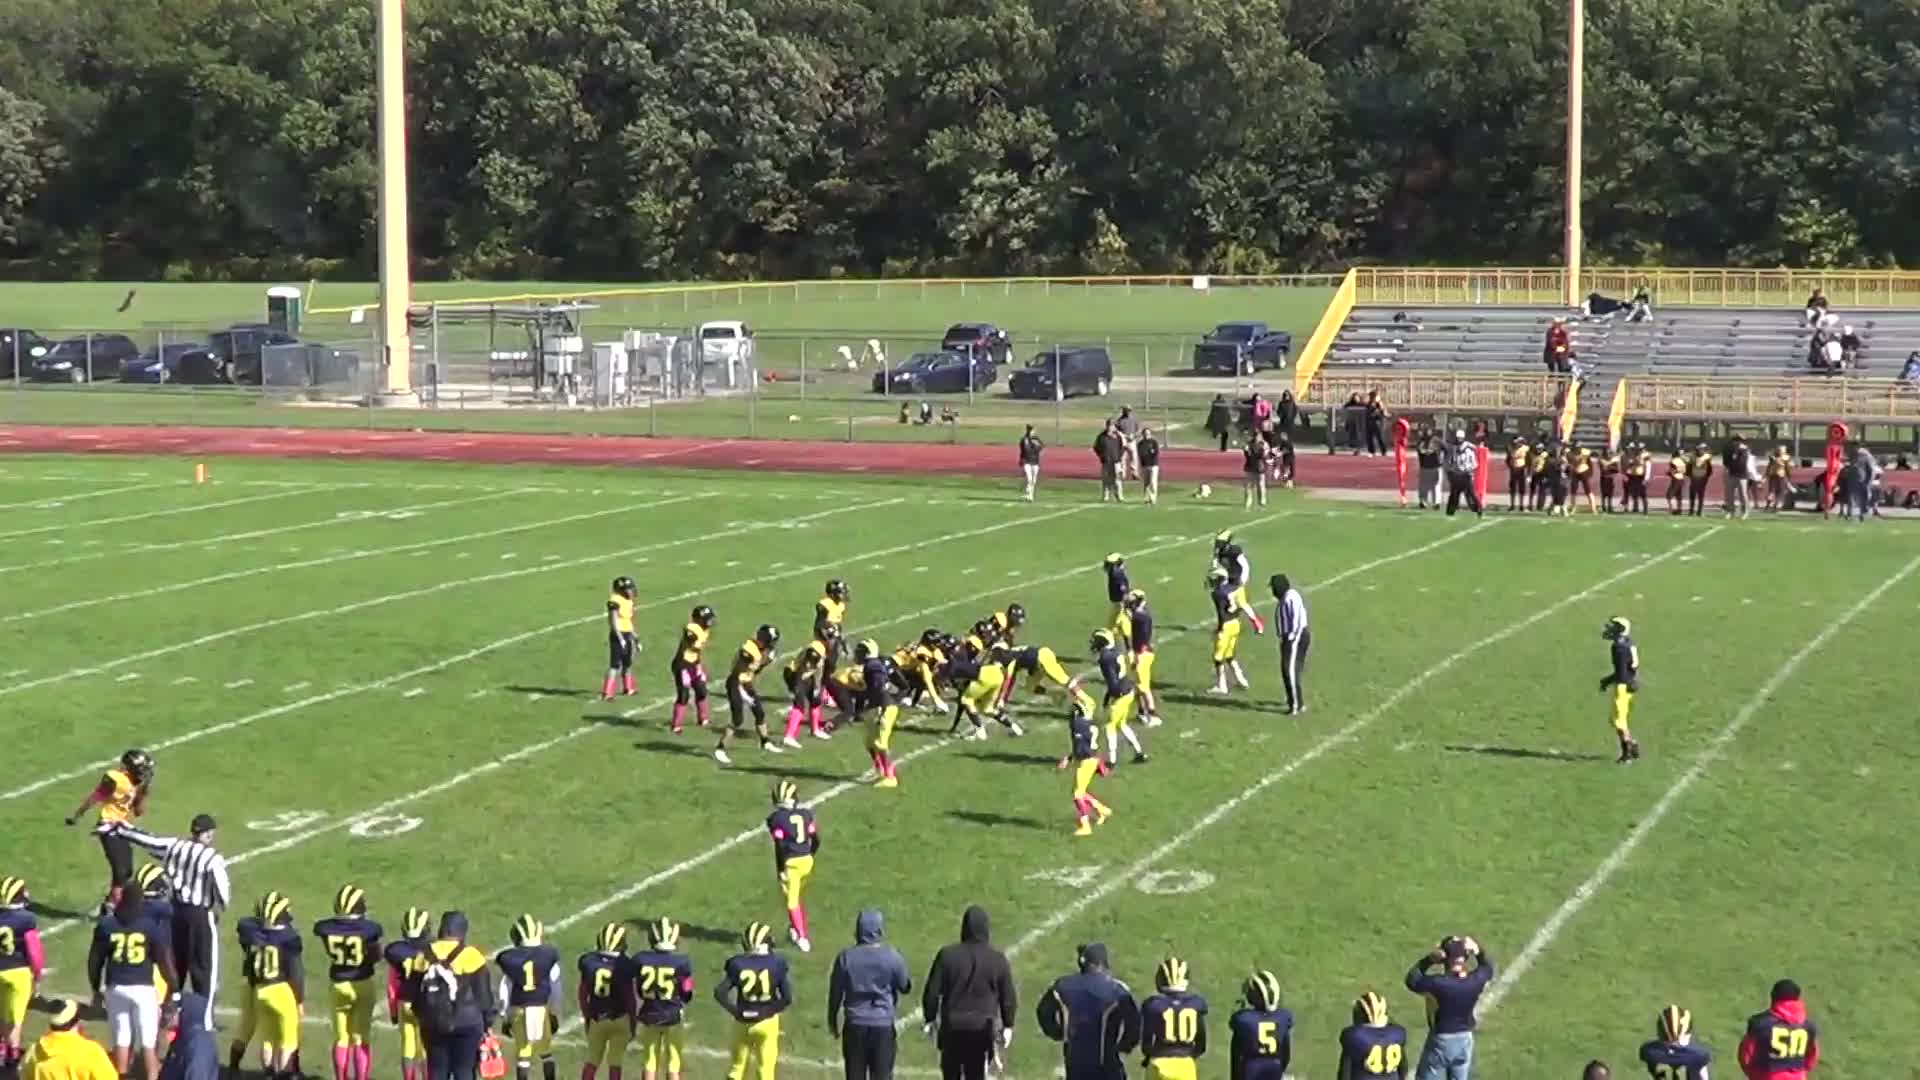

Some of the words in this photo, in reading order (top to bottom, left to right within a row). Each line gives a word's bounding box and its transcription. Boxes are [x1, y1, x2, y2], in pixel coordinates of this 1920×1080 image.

[109, 932, 146, 964] 76
[327, 934, 365, 967] 53
[522, 959, 537, 992] 1
[640, 965, 676, 1001] 25
[739, 968, 772, 1003] 21
[1162, 1008, 1198, 1045] 10
[1257, 1021, 1277, 1055] 5
[1769, 1025, 1809, 1059] 50
